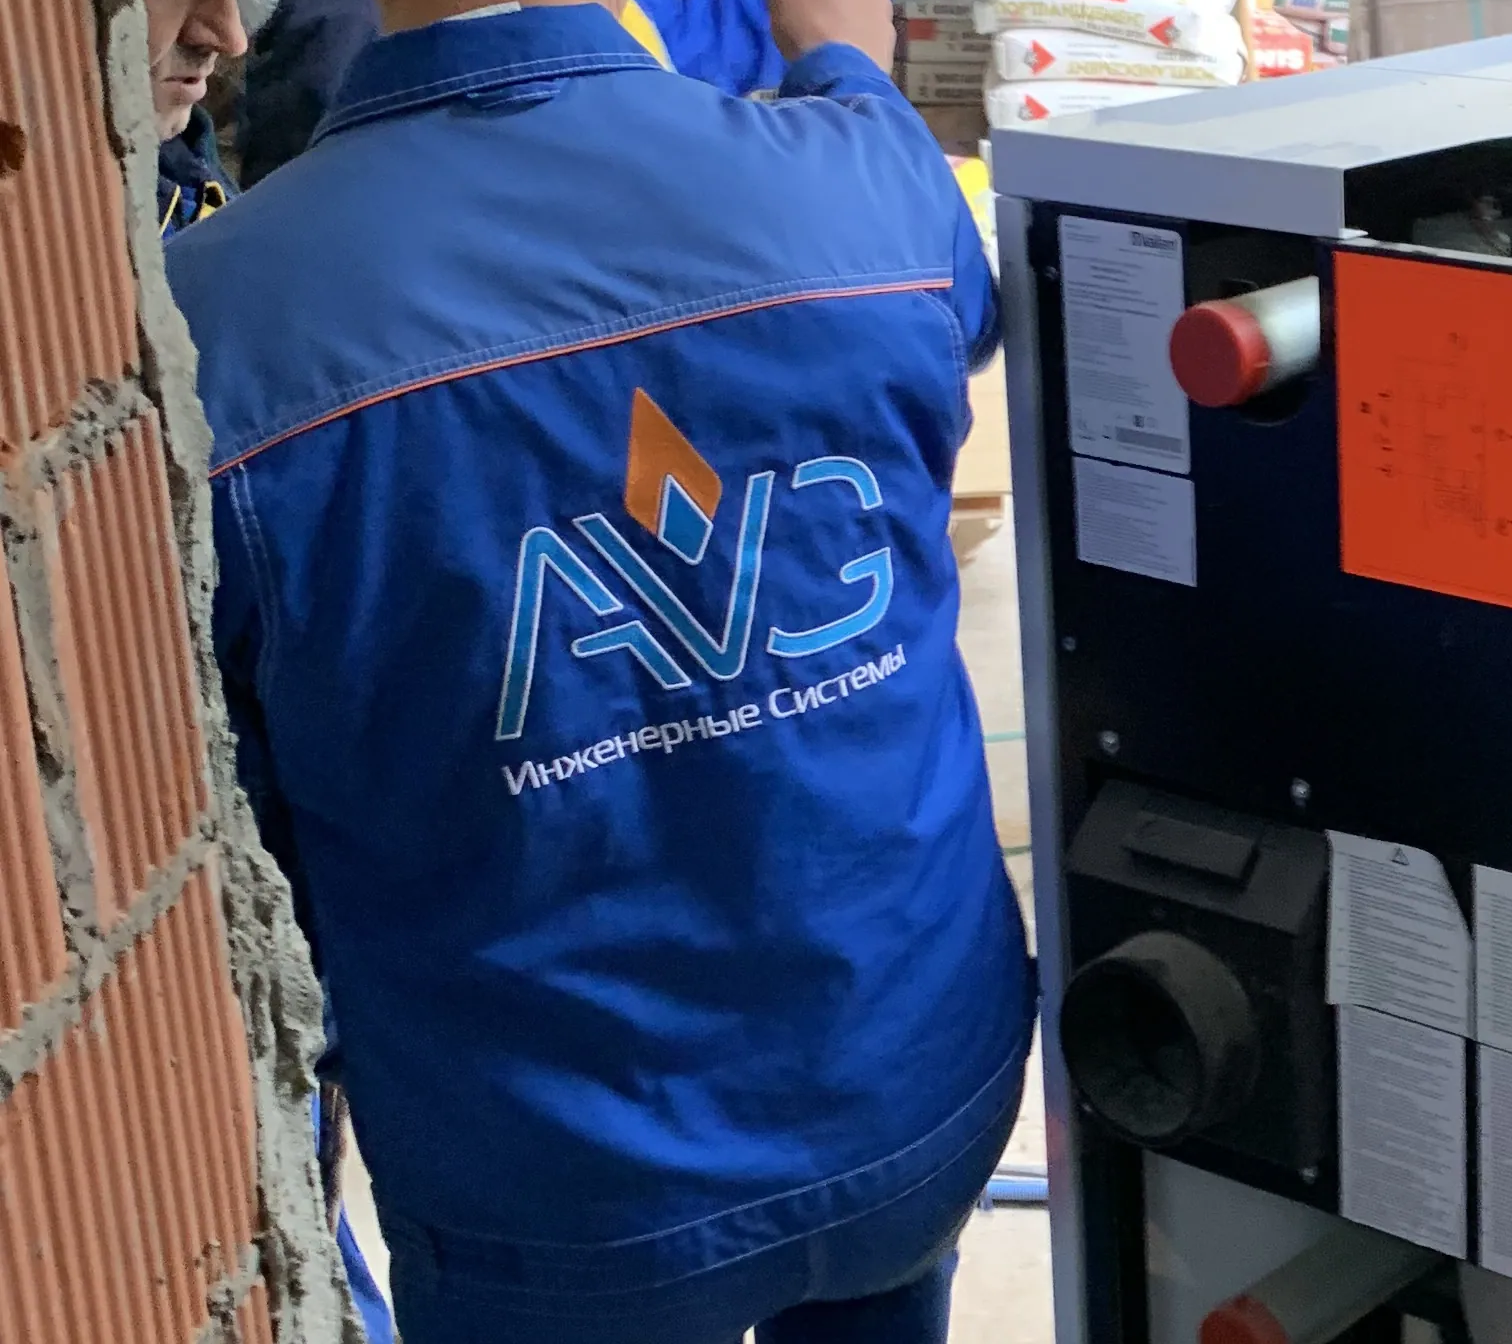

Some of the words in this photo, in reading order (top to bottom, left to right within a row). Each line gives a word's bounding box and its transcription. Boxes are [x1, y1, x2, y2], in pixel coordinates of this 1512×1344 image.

[495, 455, 894, 742] AVG
[501, 701, 761, 797] Инженерные
[768, 643, 907, 721] Системы
